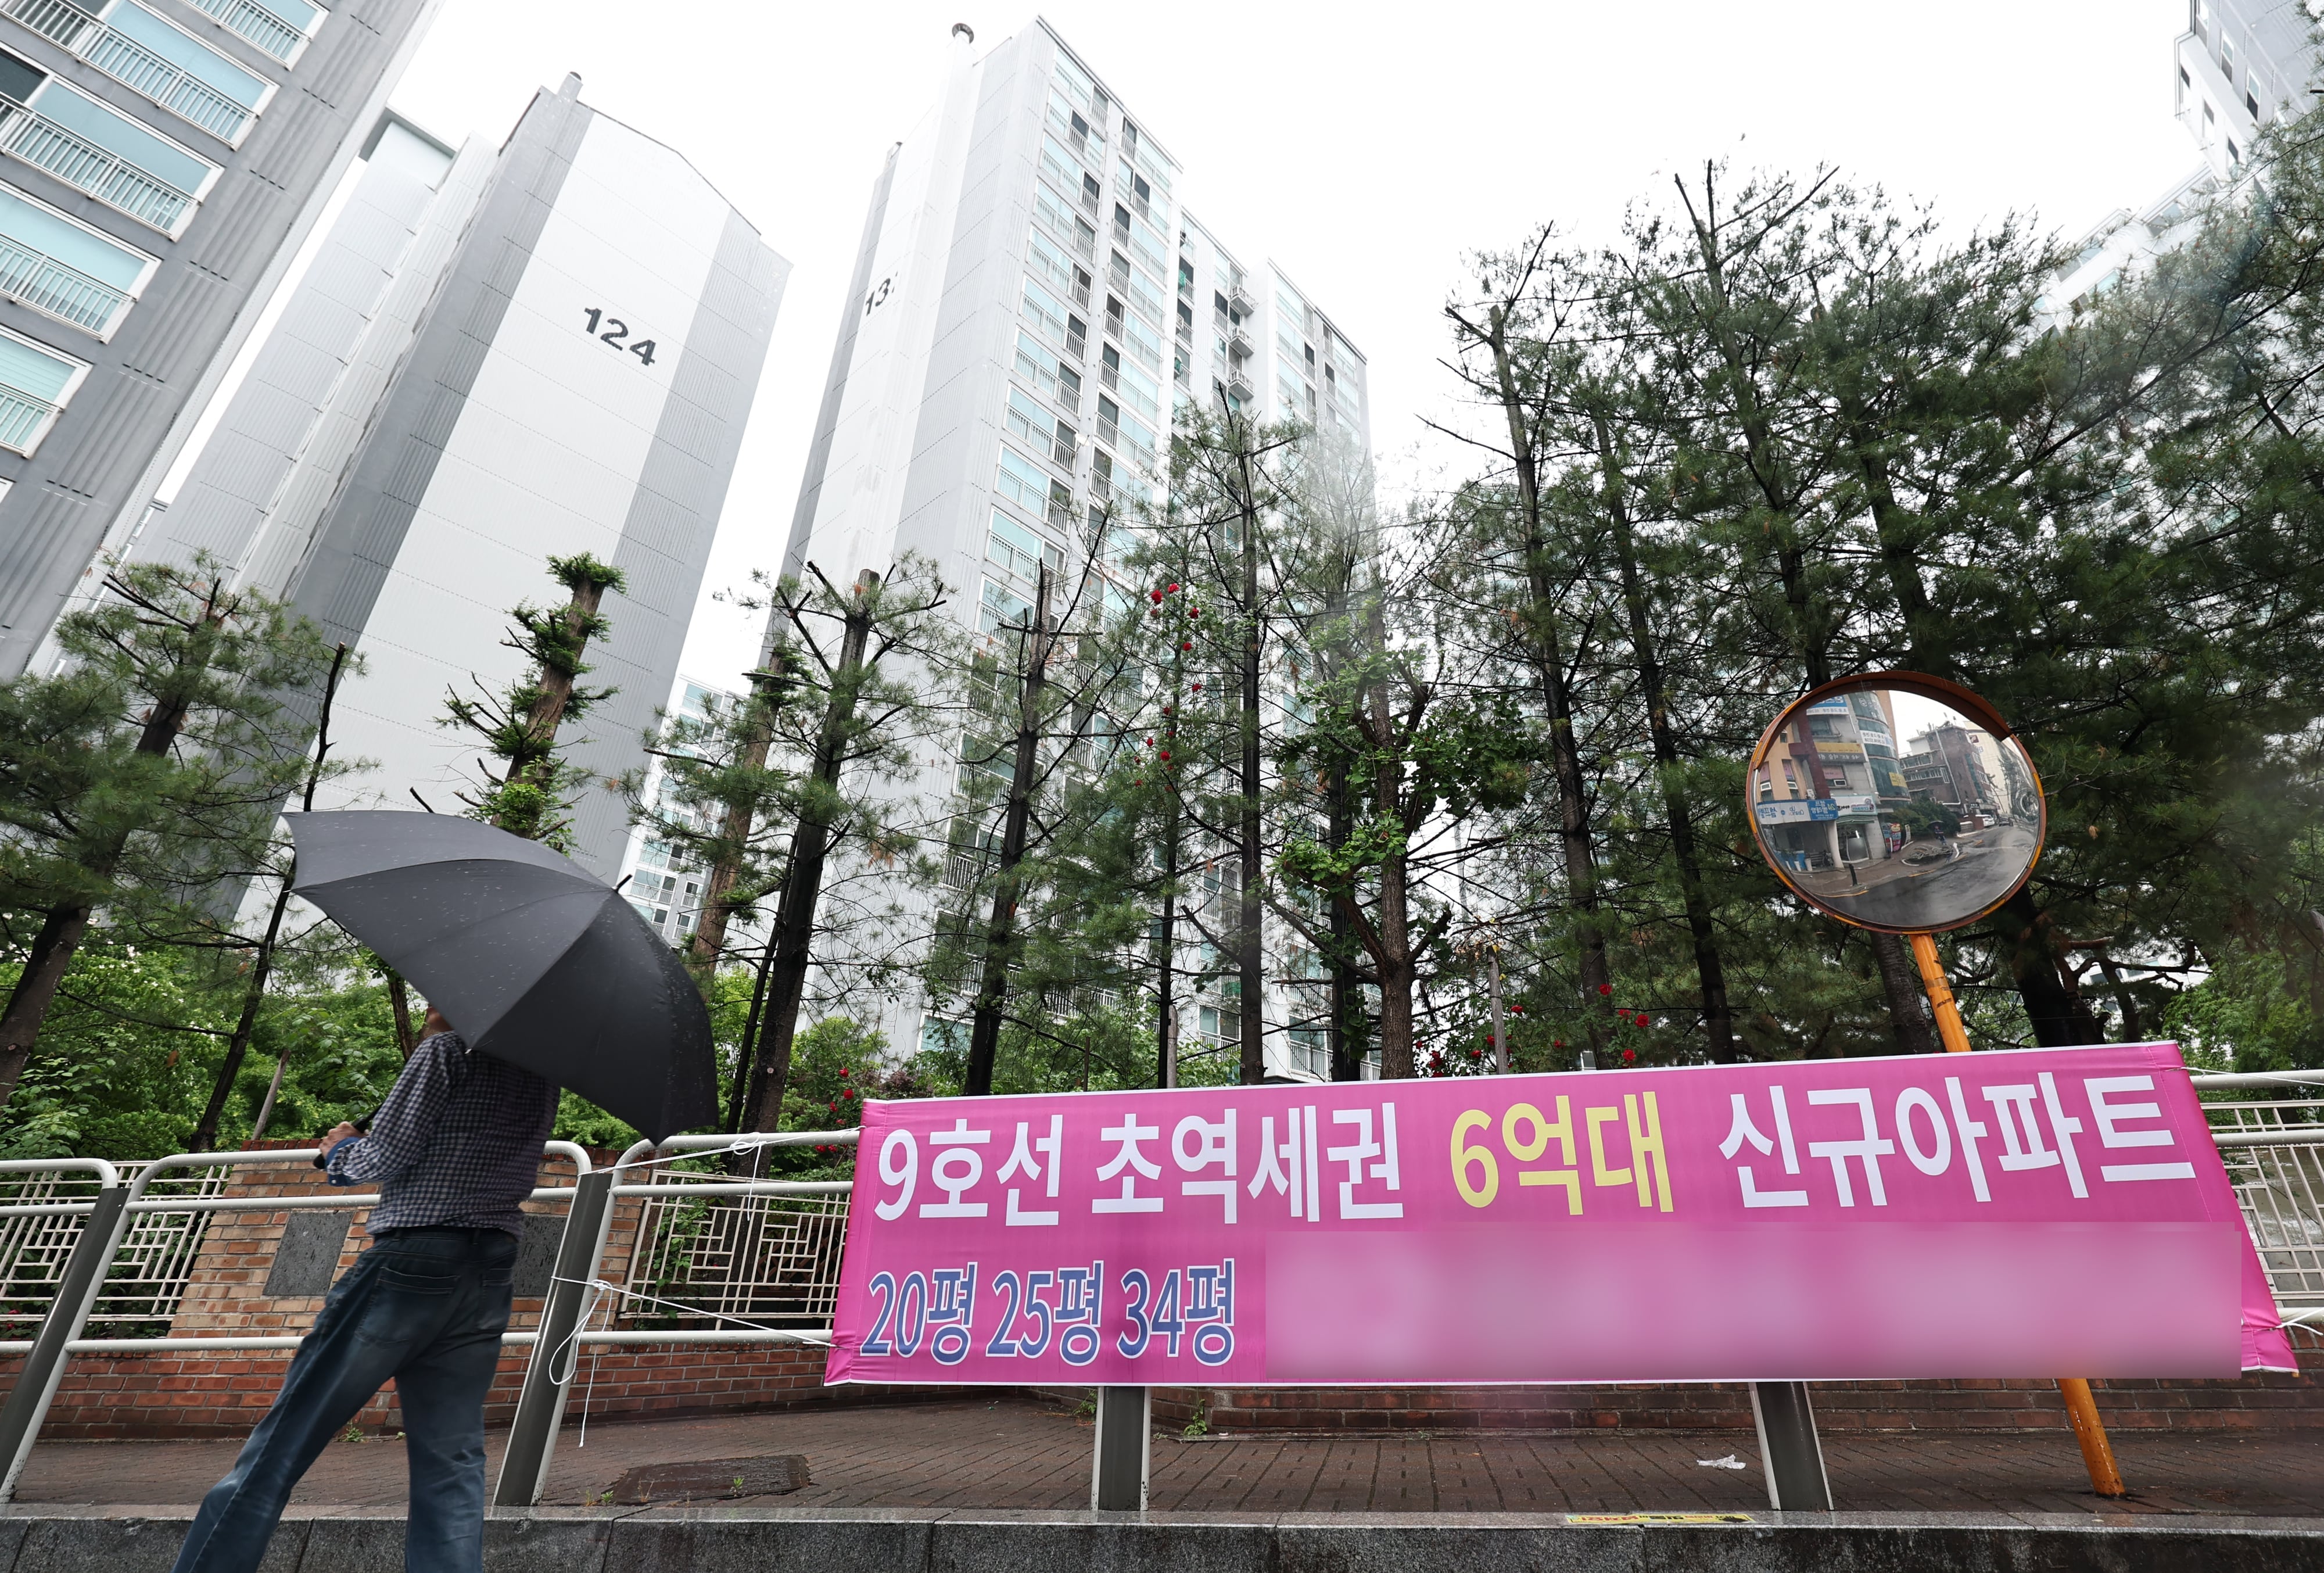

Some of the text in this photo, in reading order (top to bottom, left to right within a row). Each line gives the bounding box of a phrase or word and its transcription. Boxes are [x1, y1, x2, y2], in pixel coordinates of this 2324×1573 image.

[866, 271, 898, 316] 13
[584, 307, 656, 366] 124
[874, 1072, 2196, 1226] 9호선 초역세권 6억대 신규아파트
[860, 1262, 978, 1366] 20평
[985, 1260, 1104, 1366] 25평
[1116, 1258, 1235, 1366] 34평
